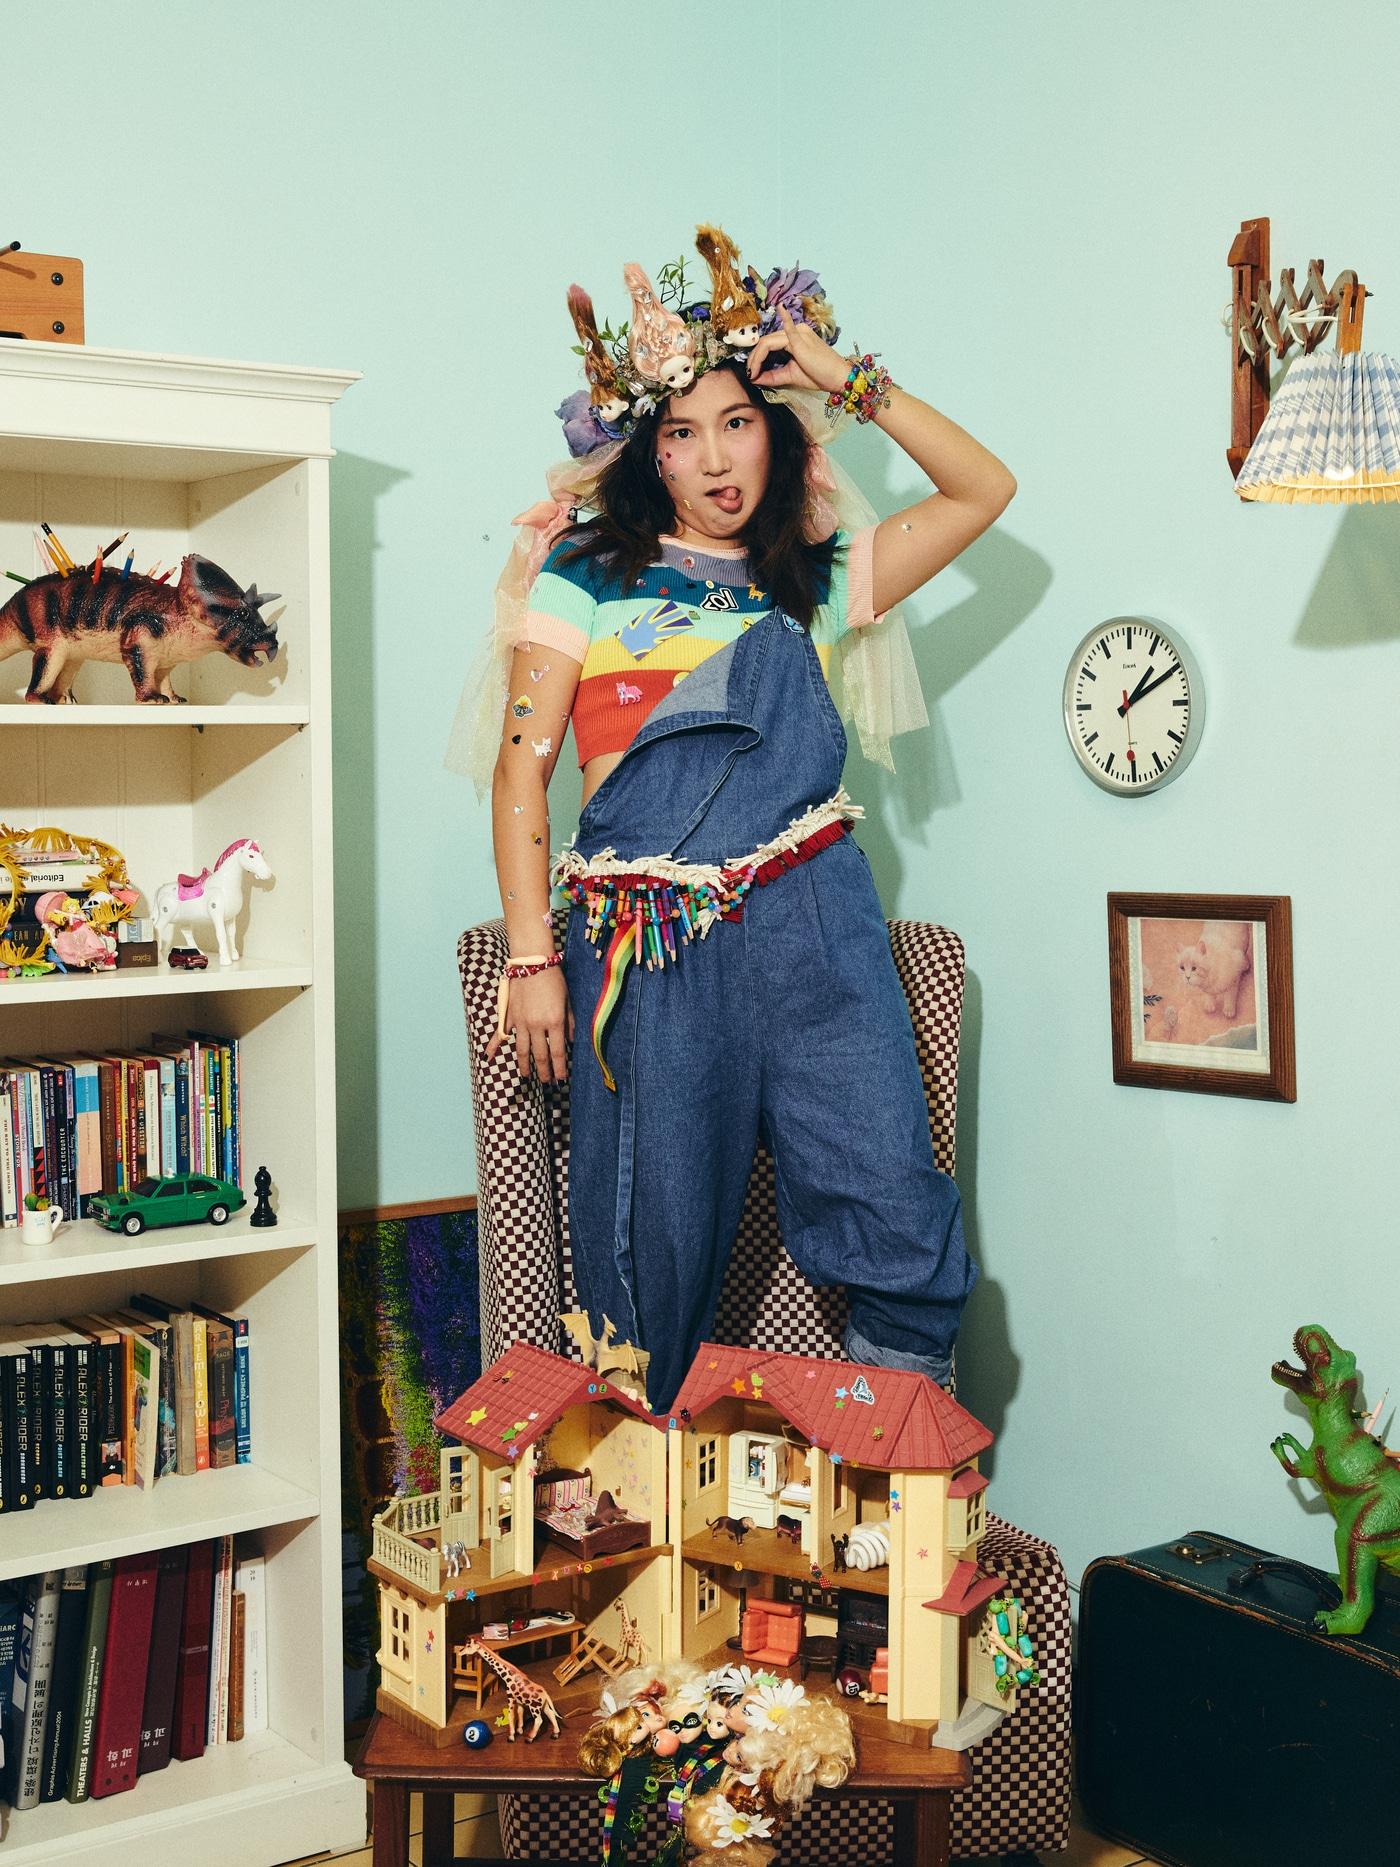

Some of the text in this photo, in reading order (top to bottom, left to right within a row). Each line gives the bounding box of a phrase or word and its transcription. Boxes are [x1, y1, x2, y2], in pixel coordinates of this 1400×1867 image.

[30, 874, 64, 882] Editorial
[131, 954, 151, 963] Epica
[5, 1148, 9, 1156] TO
[59, 1127, 67, 1162] ENCOUNTER
[16, 1376, 26, 1406] ALEX
[32, 1368, 41, 1397] ALEX
[54, 1369, 64, 1398] ALEX
[78, 1368, 88, 1397] ALEX
[32, 1407, 42, 1441] RIDER
[54, 1408, 65, 1442] RIDER
[78, 1407, 88, 1441] RIDER
[195, 1392, 206, 1429] FOWL
[16, 1417, 27, 1451] RIDER
[50, 1743, 59, 1774] Advertising
[76, 1719, 92, 1797] THEATERS & HALLS
[47, 1775, 55, 1796] Graphis
